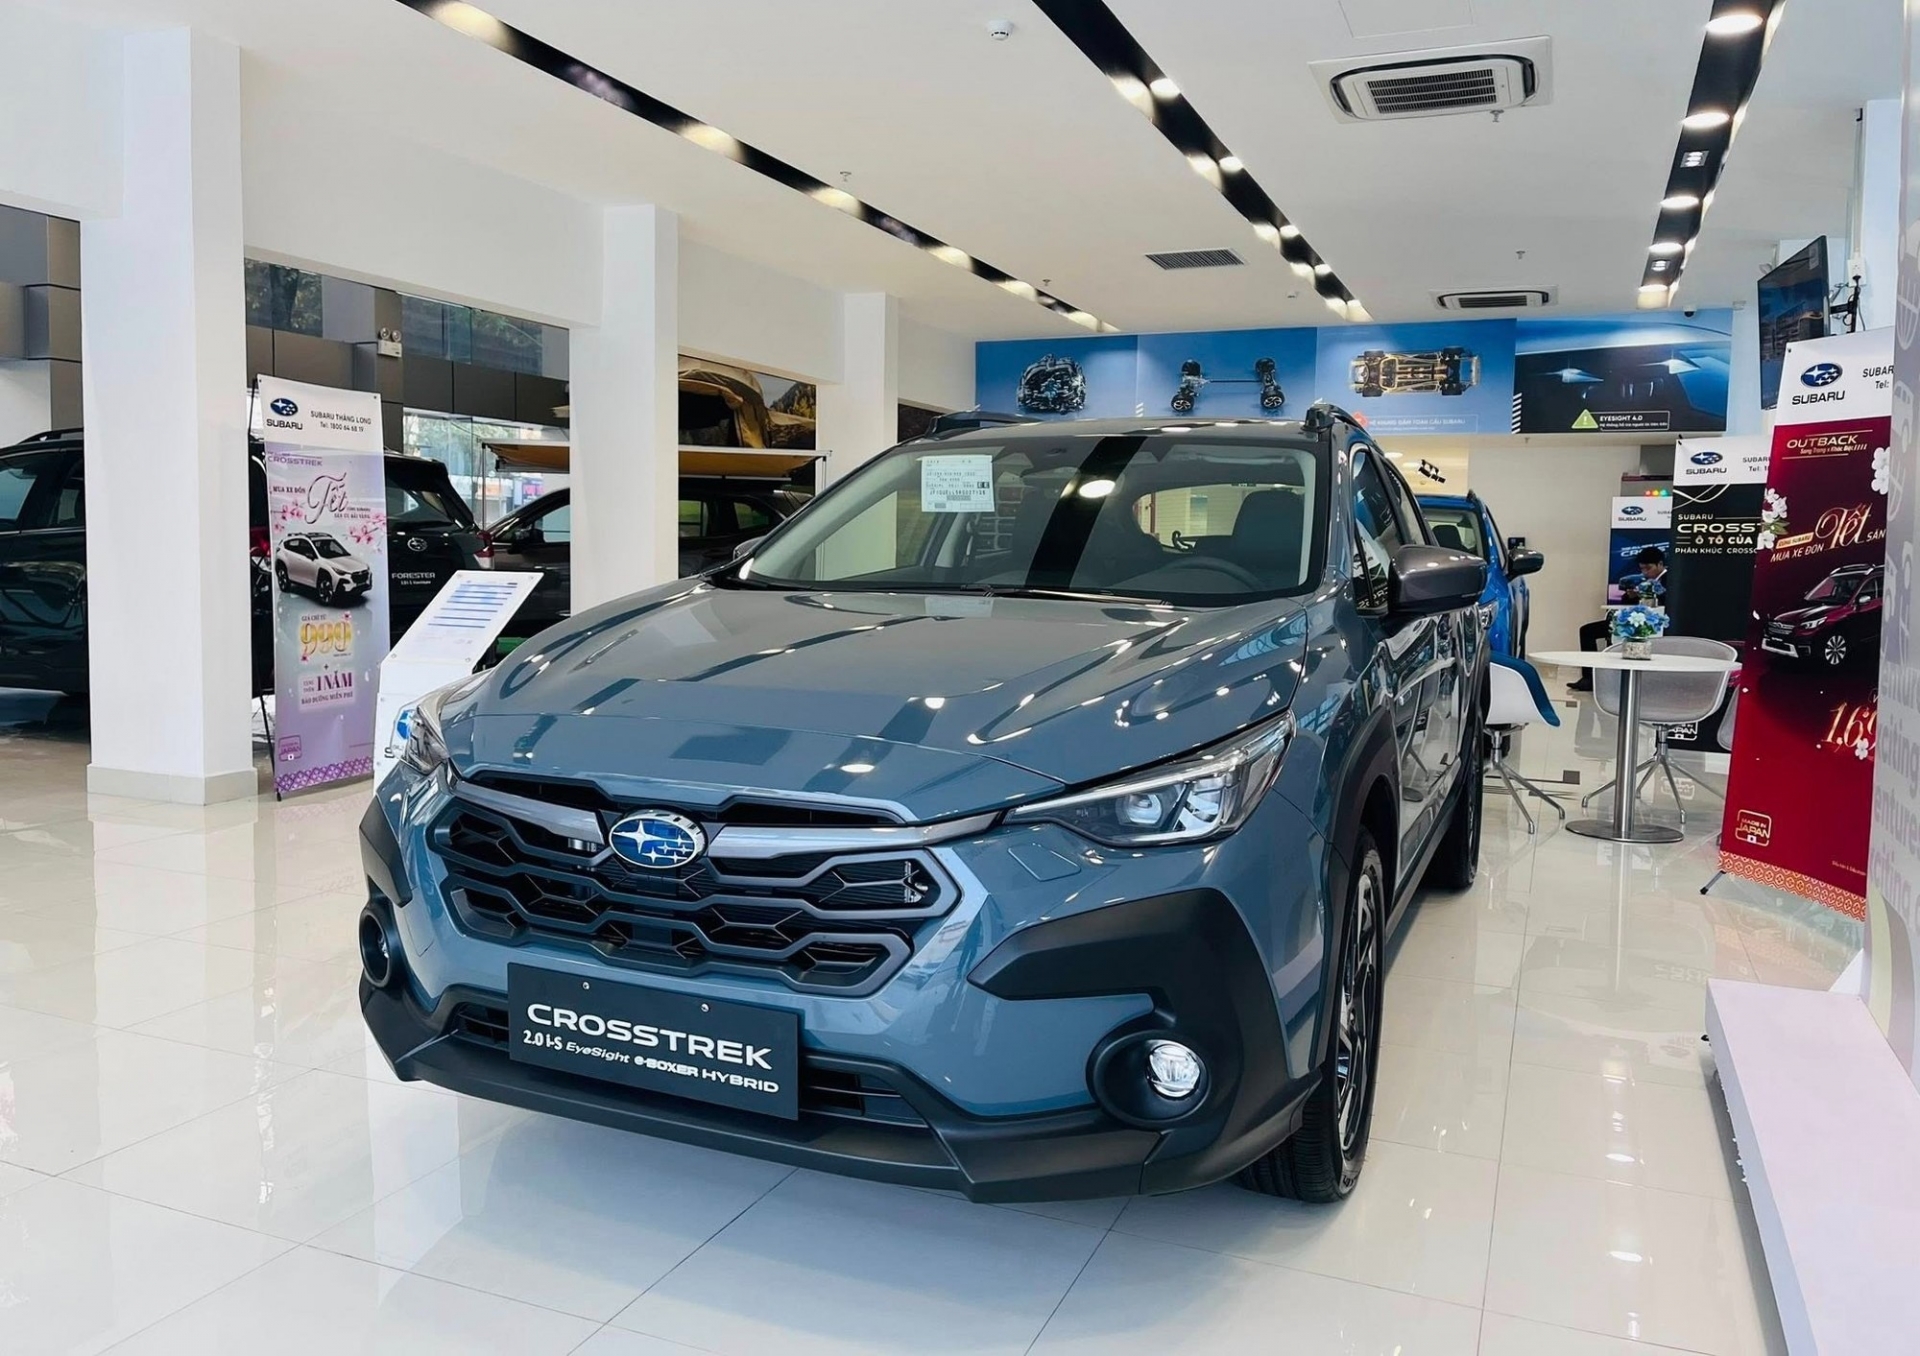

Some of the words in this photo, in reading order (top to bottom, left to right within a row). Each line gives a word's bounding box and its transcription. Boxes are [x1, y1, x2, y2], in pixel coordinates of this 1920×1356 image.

[1875, 380, 1889, 389] Tel:
[1792, 390, 1846, 405] SUBARU
[266, 418, 303, 430] SUBARU
[311, 410, 335, 420] SUBARU
[356, 417, 372, 425] LONG
[1787, 435, 1858, 449] OUTBACK
[267, 457, 323, 467] CROSSTREK
[1686, 467, 1727, 475] SUBARU
[1815, 503, 1873, 549] Tết
[1695, 535, 1704, 544] Ô
[1708, 535, 1724, 544] TÔ
[1728, 533, 1753, 544] CỦA
[1700, 546, 1723, 554] KHÚC
[1770, 551, 1790, 562] MUA
[1792, 547, 1804, 558] XE
[301, 621, 352, 656] 999
[1741, 818, 1760, 827] MADE
[1740, 823, 1770, 838] JAPAN
[527, 1003, 773, 1070] CROSSTREK
[523, 1030, 544, 1047] 2.0
[565, 1041, 630, 1064] EyeSight
[702, 1068, 779, 1093] HYBRID
